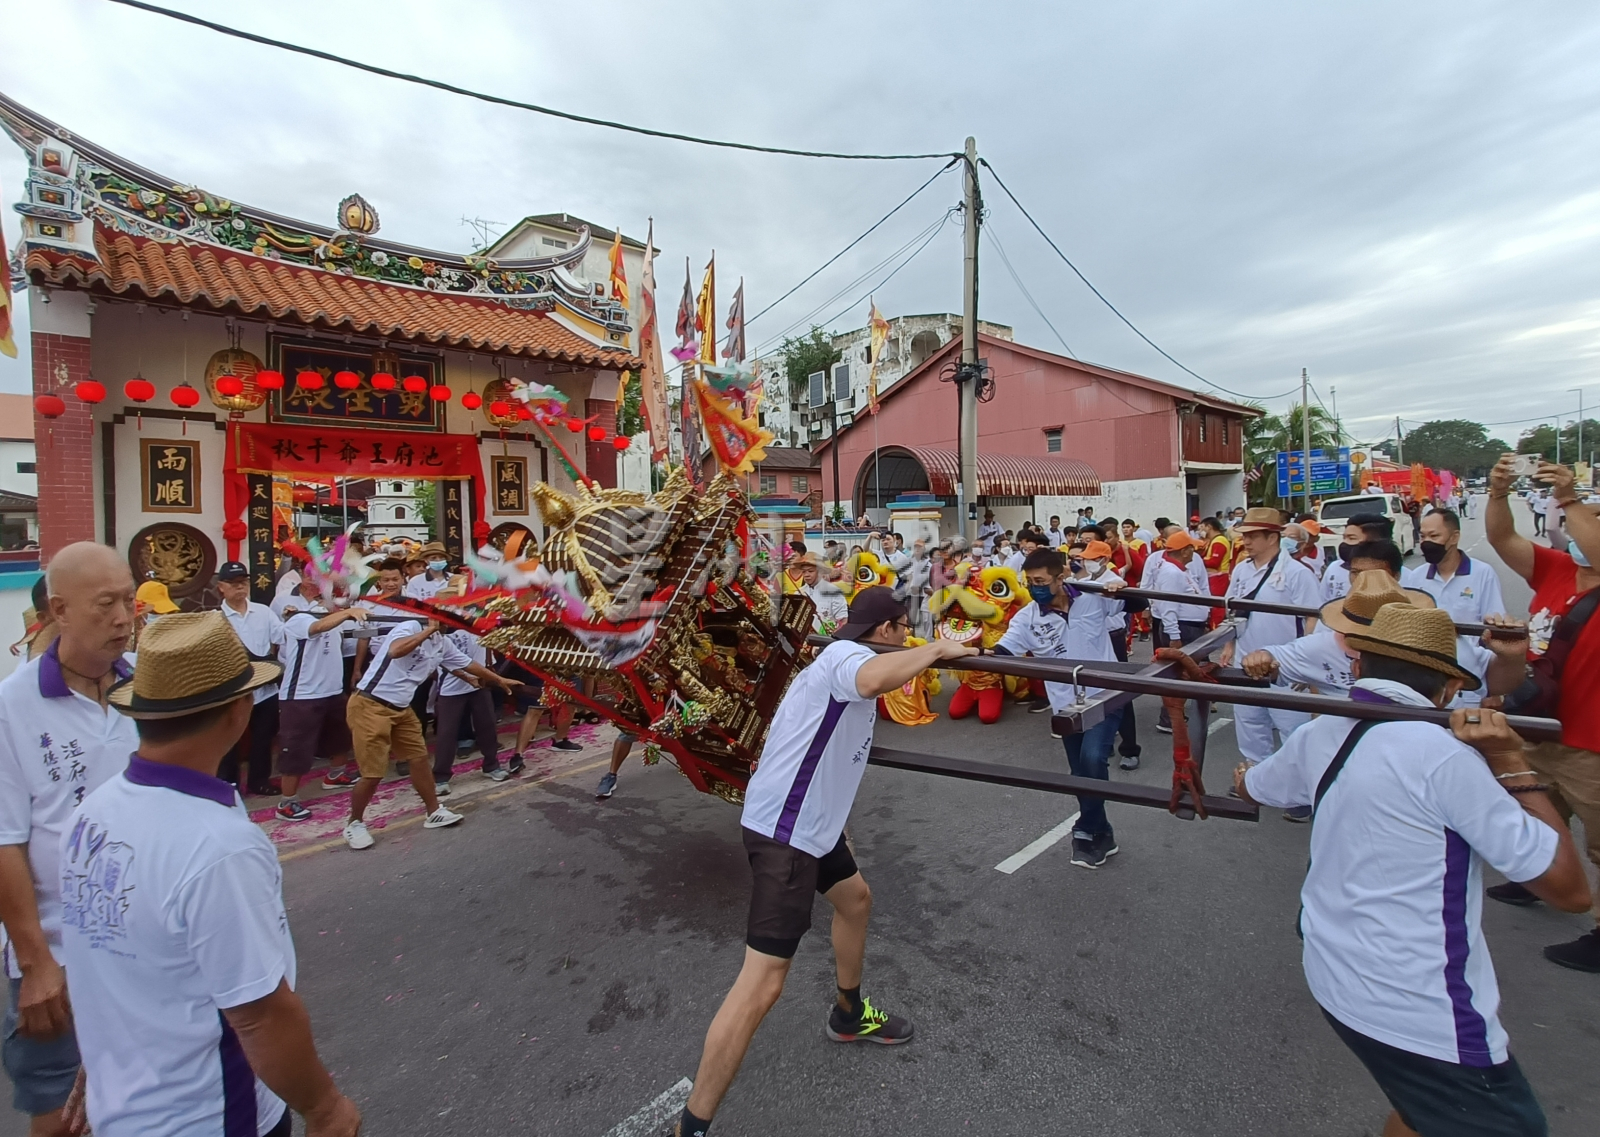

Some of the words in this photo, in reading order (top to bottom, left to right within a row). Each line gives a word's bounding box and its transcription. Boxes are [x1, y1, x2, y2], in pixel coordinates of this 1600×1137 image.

[155, 447, 187, 505] 雨順
[500, 462, 521, 509] 風調
[252, 473, 272, 591] 天巡狩王爺
